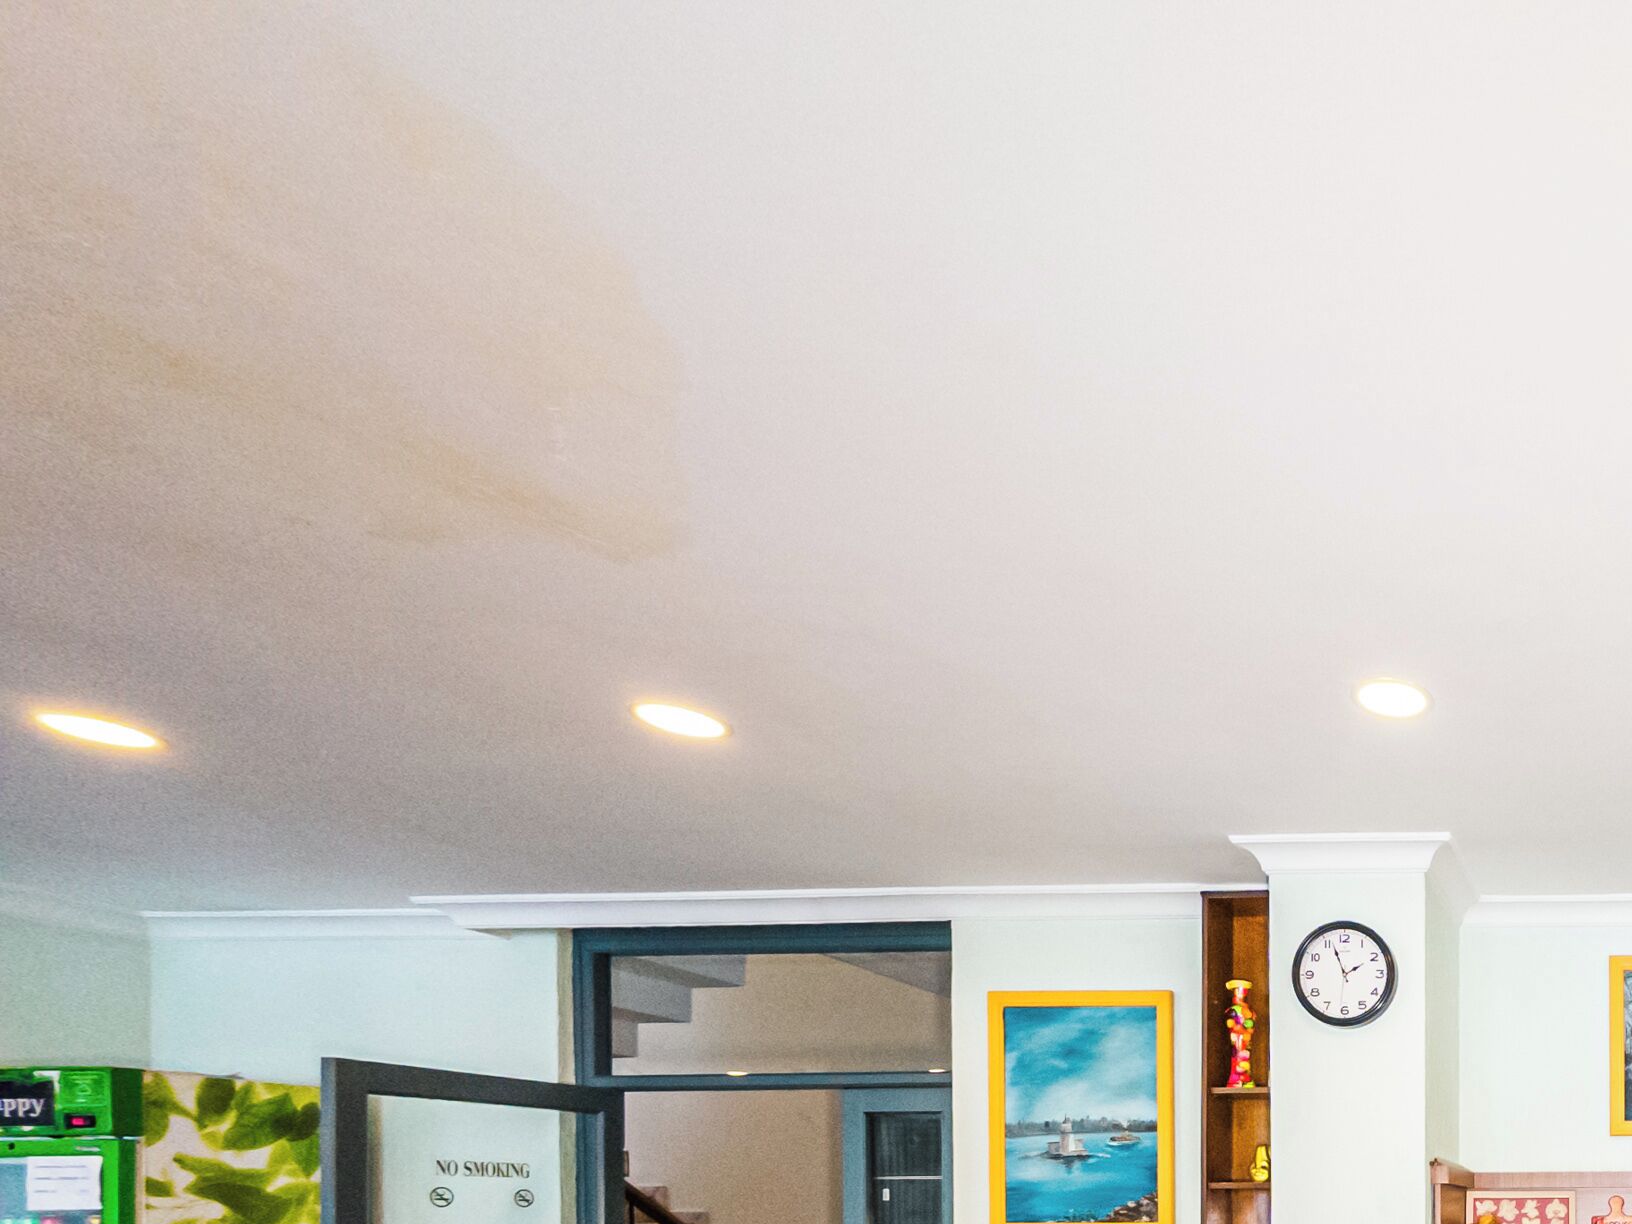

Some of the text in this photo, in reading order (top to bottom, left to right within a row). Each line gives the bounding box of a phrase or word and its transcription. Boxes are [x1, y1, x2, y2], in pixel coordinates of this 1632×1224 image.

[1339, 934, 1350, 943] 12
[1324, 939, 1331, 948] 11
[1361, 939, 1364, 948] 1
[1311, 953, 1321, 962] 10
[1370, 953, 1379, 961] 2
[1305, 970, 1314, 979] 9
[1376, 970, 1384, 979] 3
[1310, 988, 1320, 997] 8
[1370, 988, 1378, 996] 4
[1323, 1001, 1331, 1010] 7
[1358, 1001, 1367, 1010] 5
[1340, 1006, 1349, 1015] 6
[435, 1160, 530, 1178] NO SMOKING
